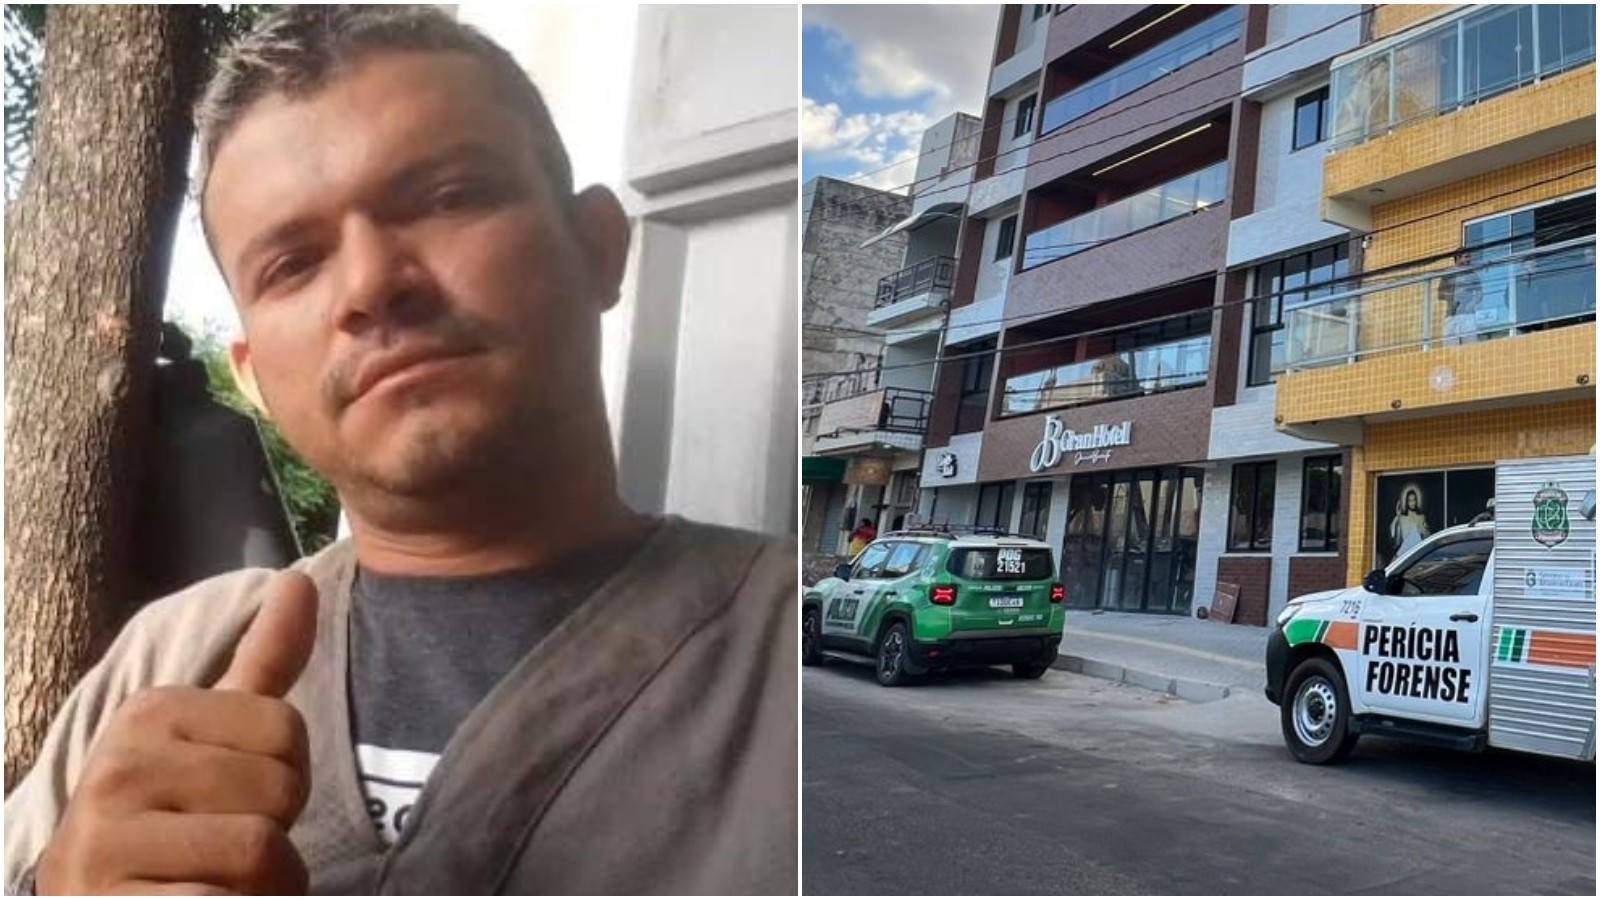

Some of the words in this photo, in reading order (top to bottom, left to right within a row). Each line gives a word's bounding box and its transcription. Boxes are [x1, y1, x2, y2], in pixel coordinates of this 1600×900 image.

[996, 560, 1026, 574] 21521
[1362, 621, 1460, 663] PERÍCIA
[1365, 660, 1472, 704] FORENSE
